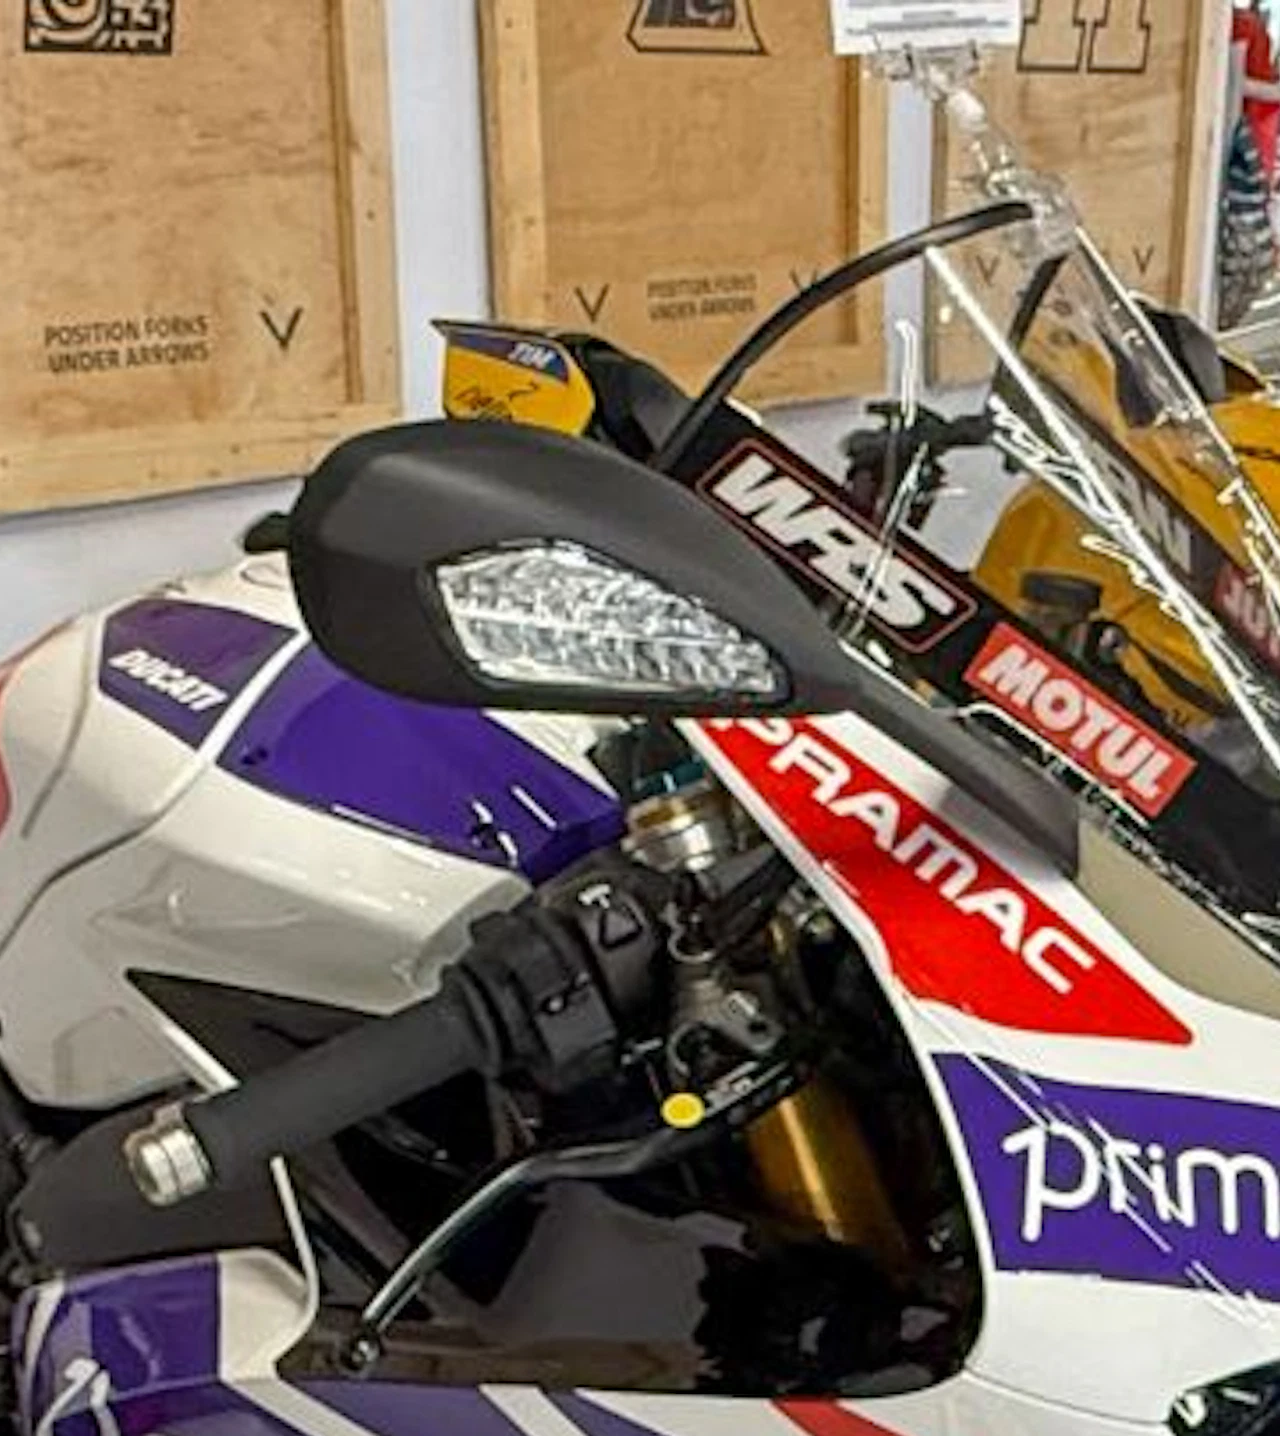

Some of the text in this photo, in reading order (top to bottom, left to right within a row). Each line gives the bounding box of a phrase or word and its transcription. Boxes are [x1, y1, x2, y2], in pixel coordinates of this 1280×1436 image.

[44, 314, 208, 347] POSITION FORKS
[48, 340, 209, 375] UNDER ARROWS
[711, 453, 956, 629] WRS
[107, 648, 228, 712] DUCATI
[979, 642, 1179, 801] MOTUL
[704, 715, 1097, 995] PRAMAC
